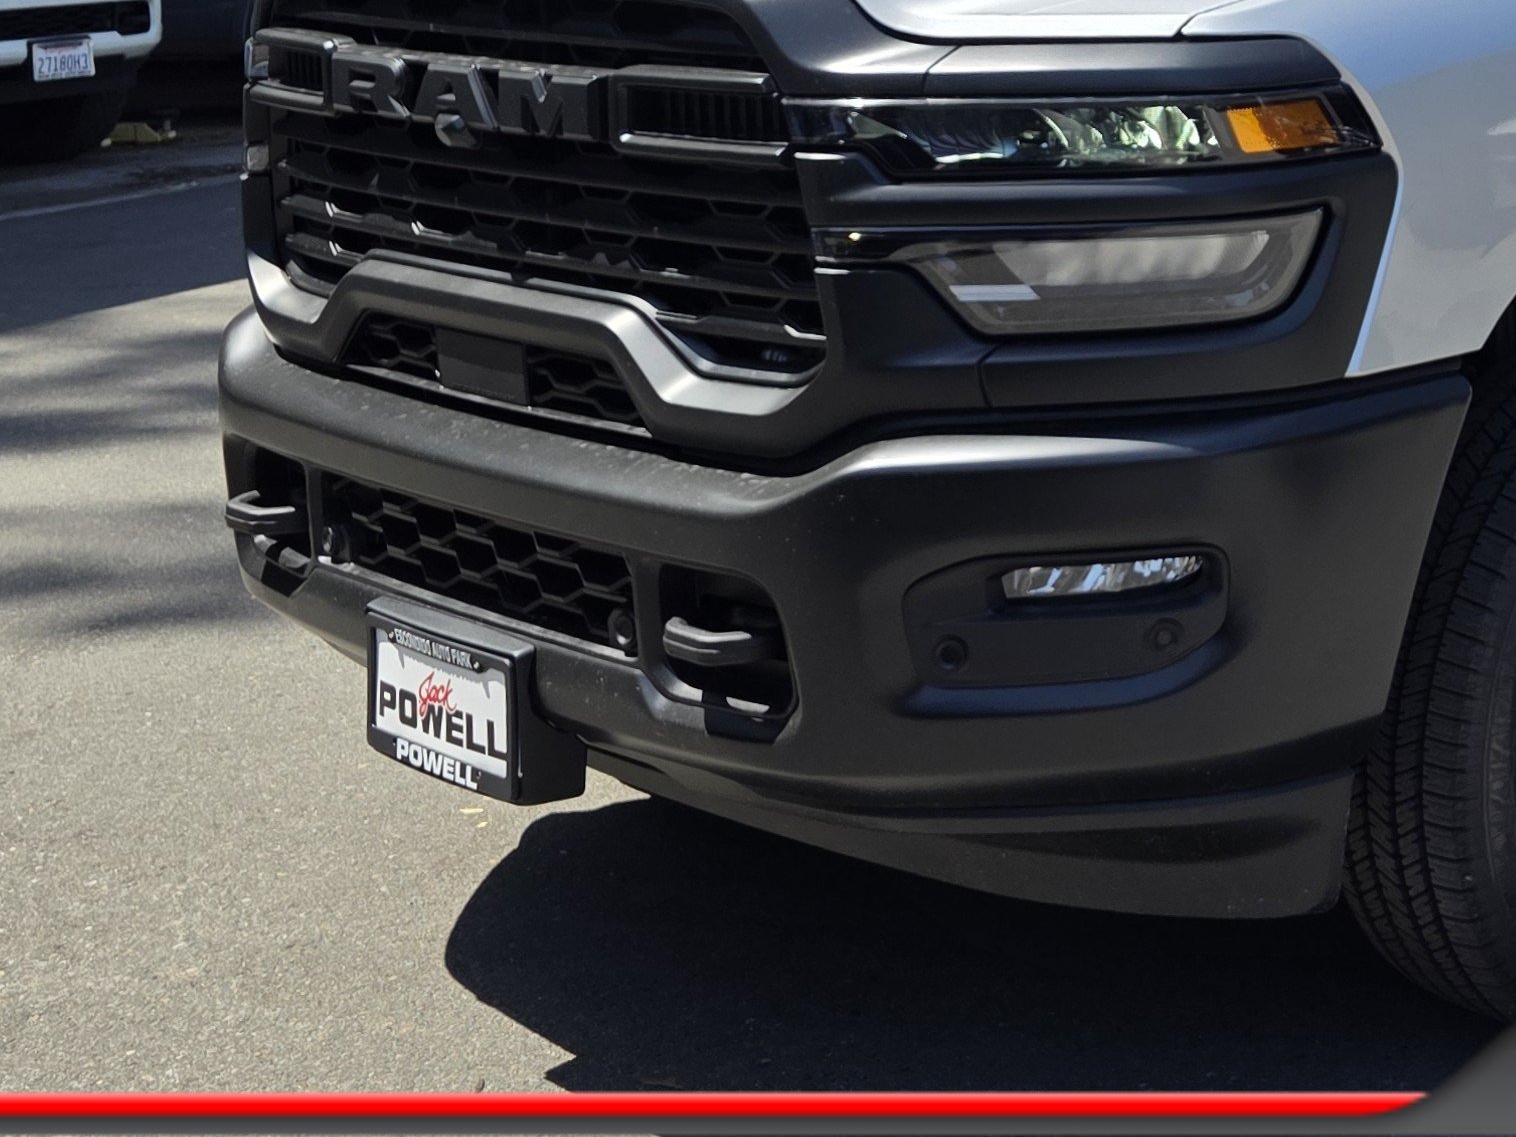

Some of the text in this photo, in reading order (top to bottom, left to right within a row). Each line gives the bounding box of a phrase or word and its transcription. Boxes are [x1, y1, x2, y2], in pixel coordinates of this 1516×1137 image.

[331, 45, 602, 142] RAM
[451, 647, 473, 669] PARK
[379, 679, 508, 762] POWELL
[418, 670, 457, 718] Jack
[395, 736, 478, 791] POWELL
